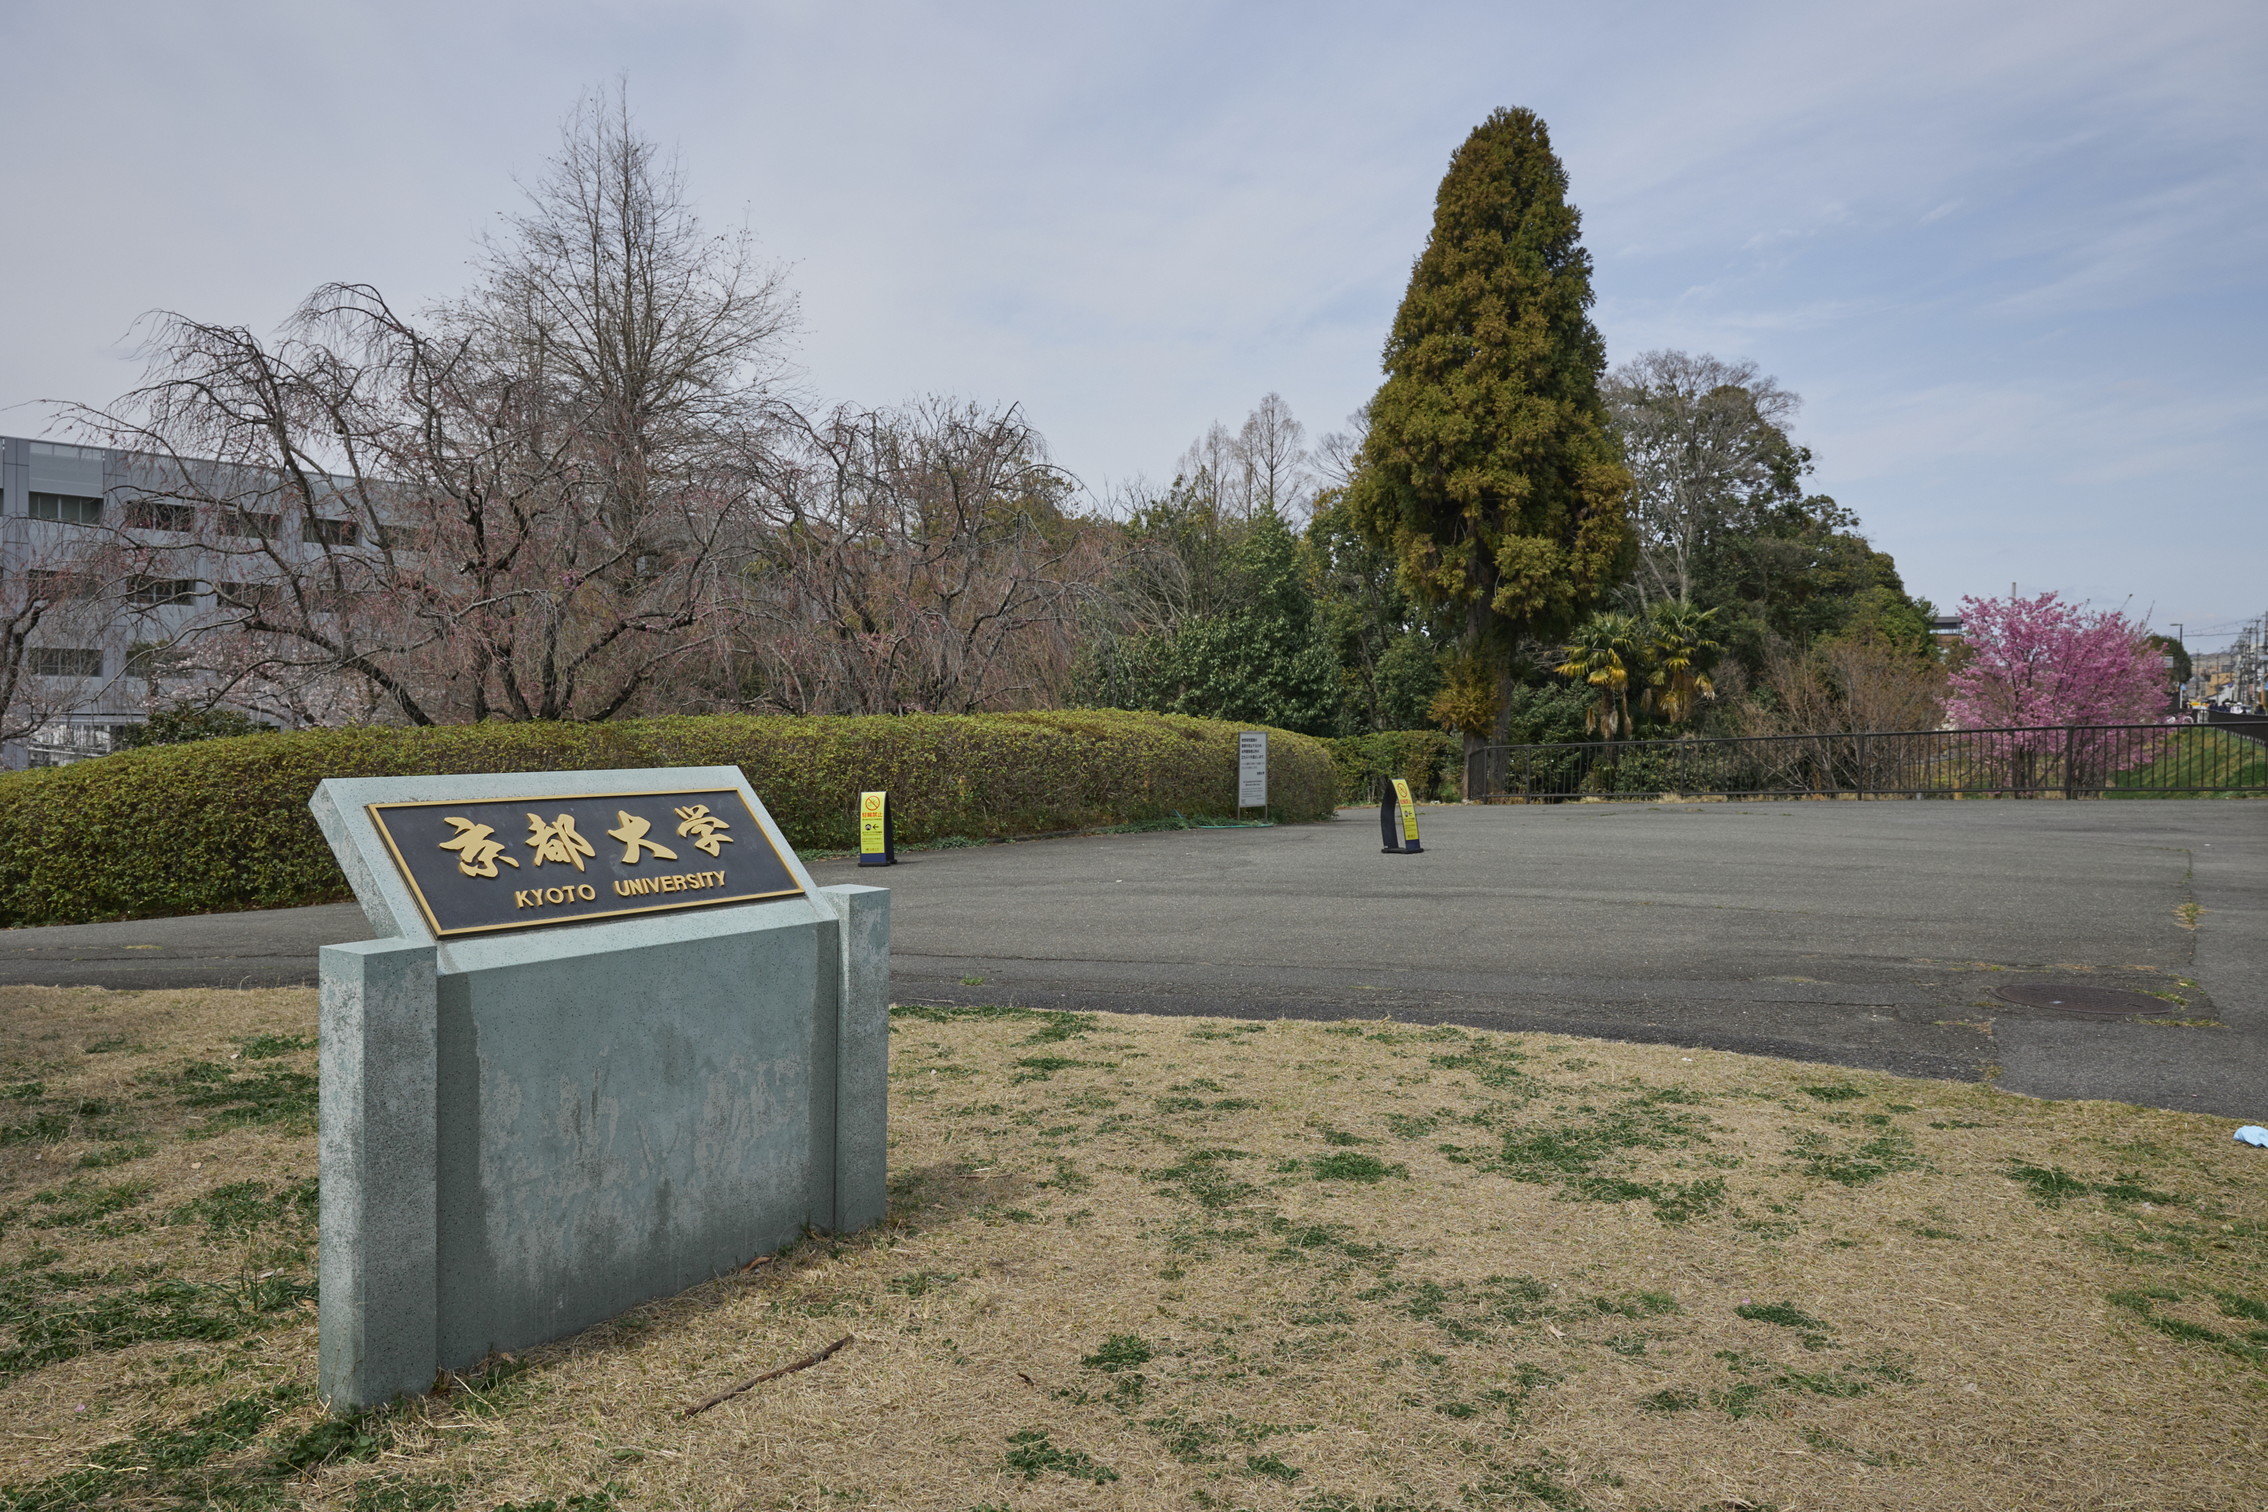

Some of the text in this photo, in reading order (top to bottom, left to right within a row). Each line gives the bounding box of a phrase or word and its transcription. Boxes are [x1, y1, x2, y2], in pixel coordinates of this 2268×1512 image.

[438, 804, 734, 878] 京都大学
[515, 870, 727, 909] KYOTO UNIVERSITY
